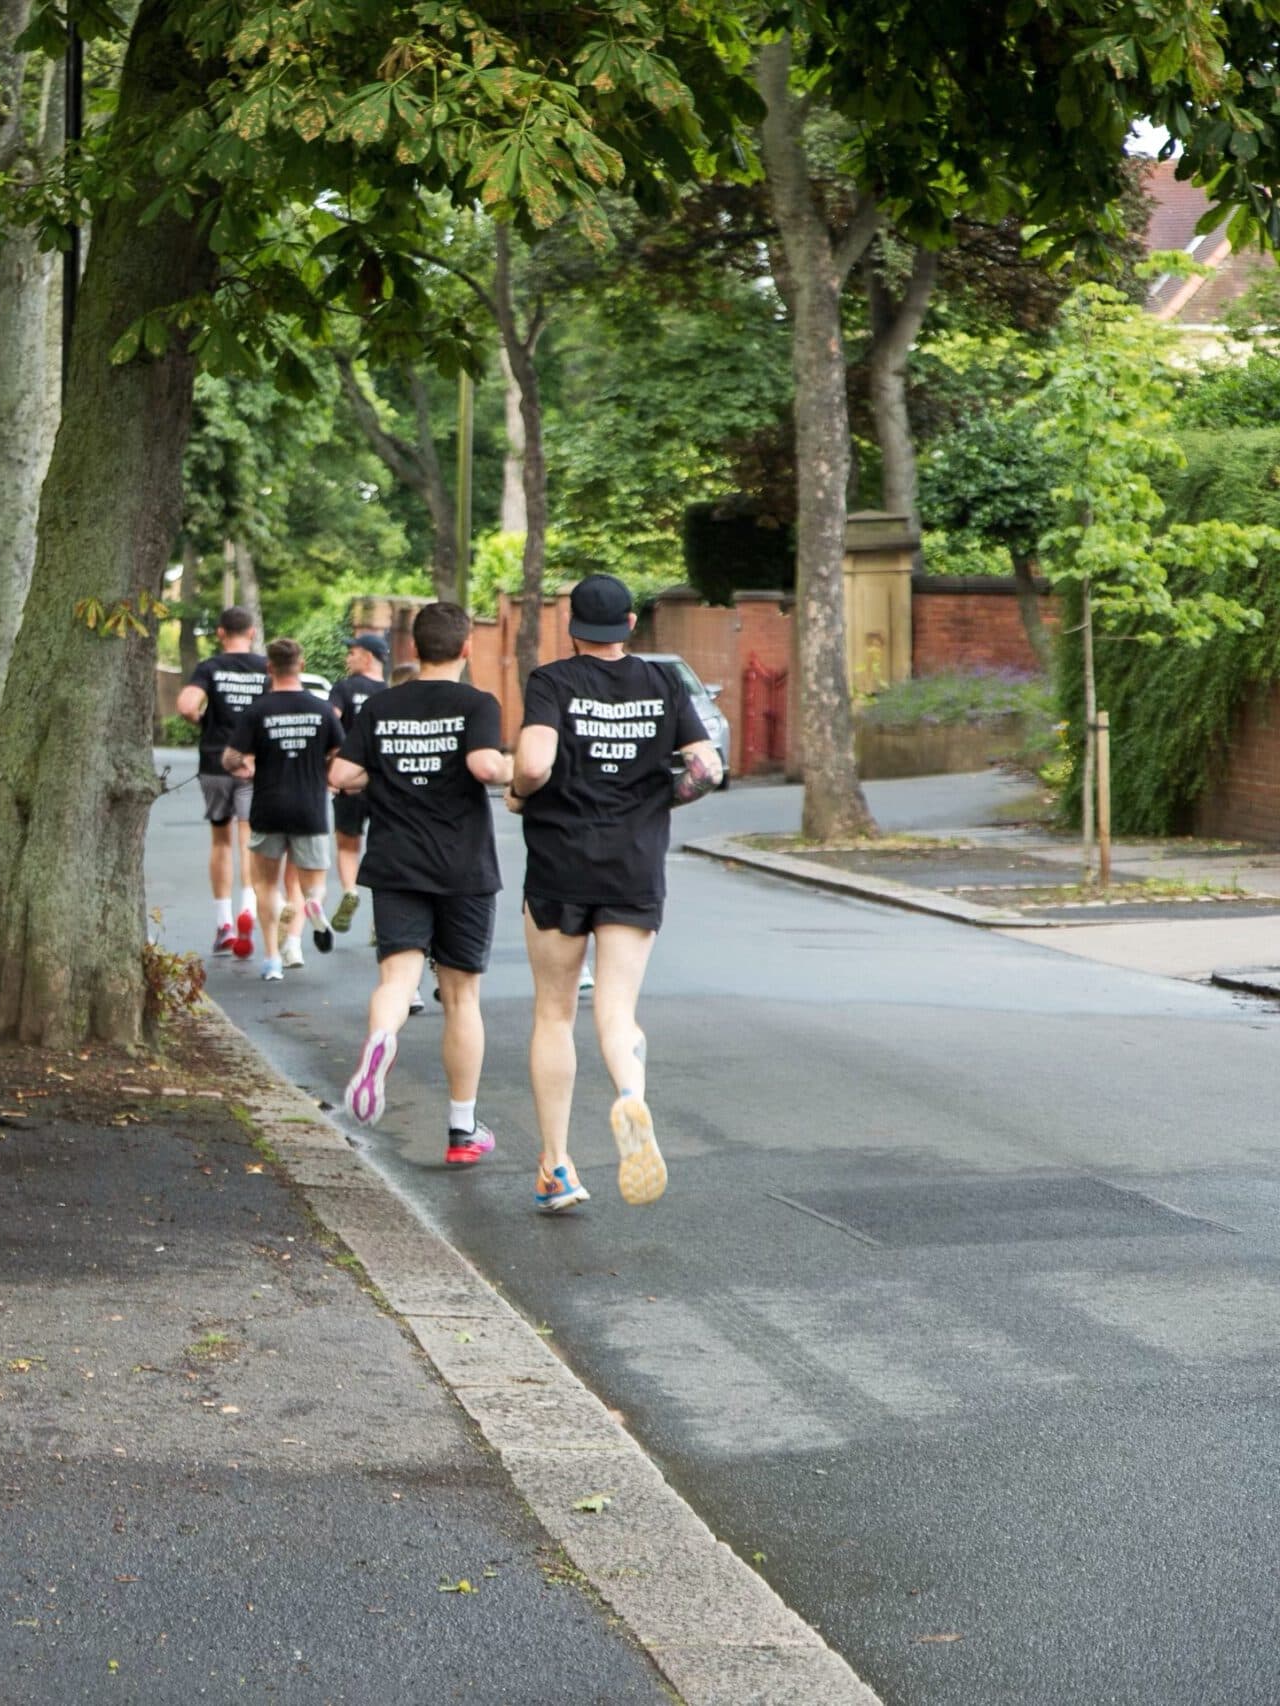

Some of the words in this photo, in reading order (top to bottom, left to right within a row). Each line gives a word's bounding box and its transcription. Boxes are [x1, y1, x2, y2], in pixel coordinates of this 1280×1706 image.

[568, 697, 665, 719] APHRODITE
[375, 716, 465, 735] APHRODITE
[575, 719, 657, 738] RUNNING
[380, 736, 458, 754] RUNNING
[590, 742, 637, 759] CLUB
[397, 757, 441, 773] CLUB
